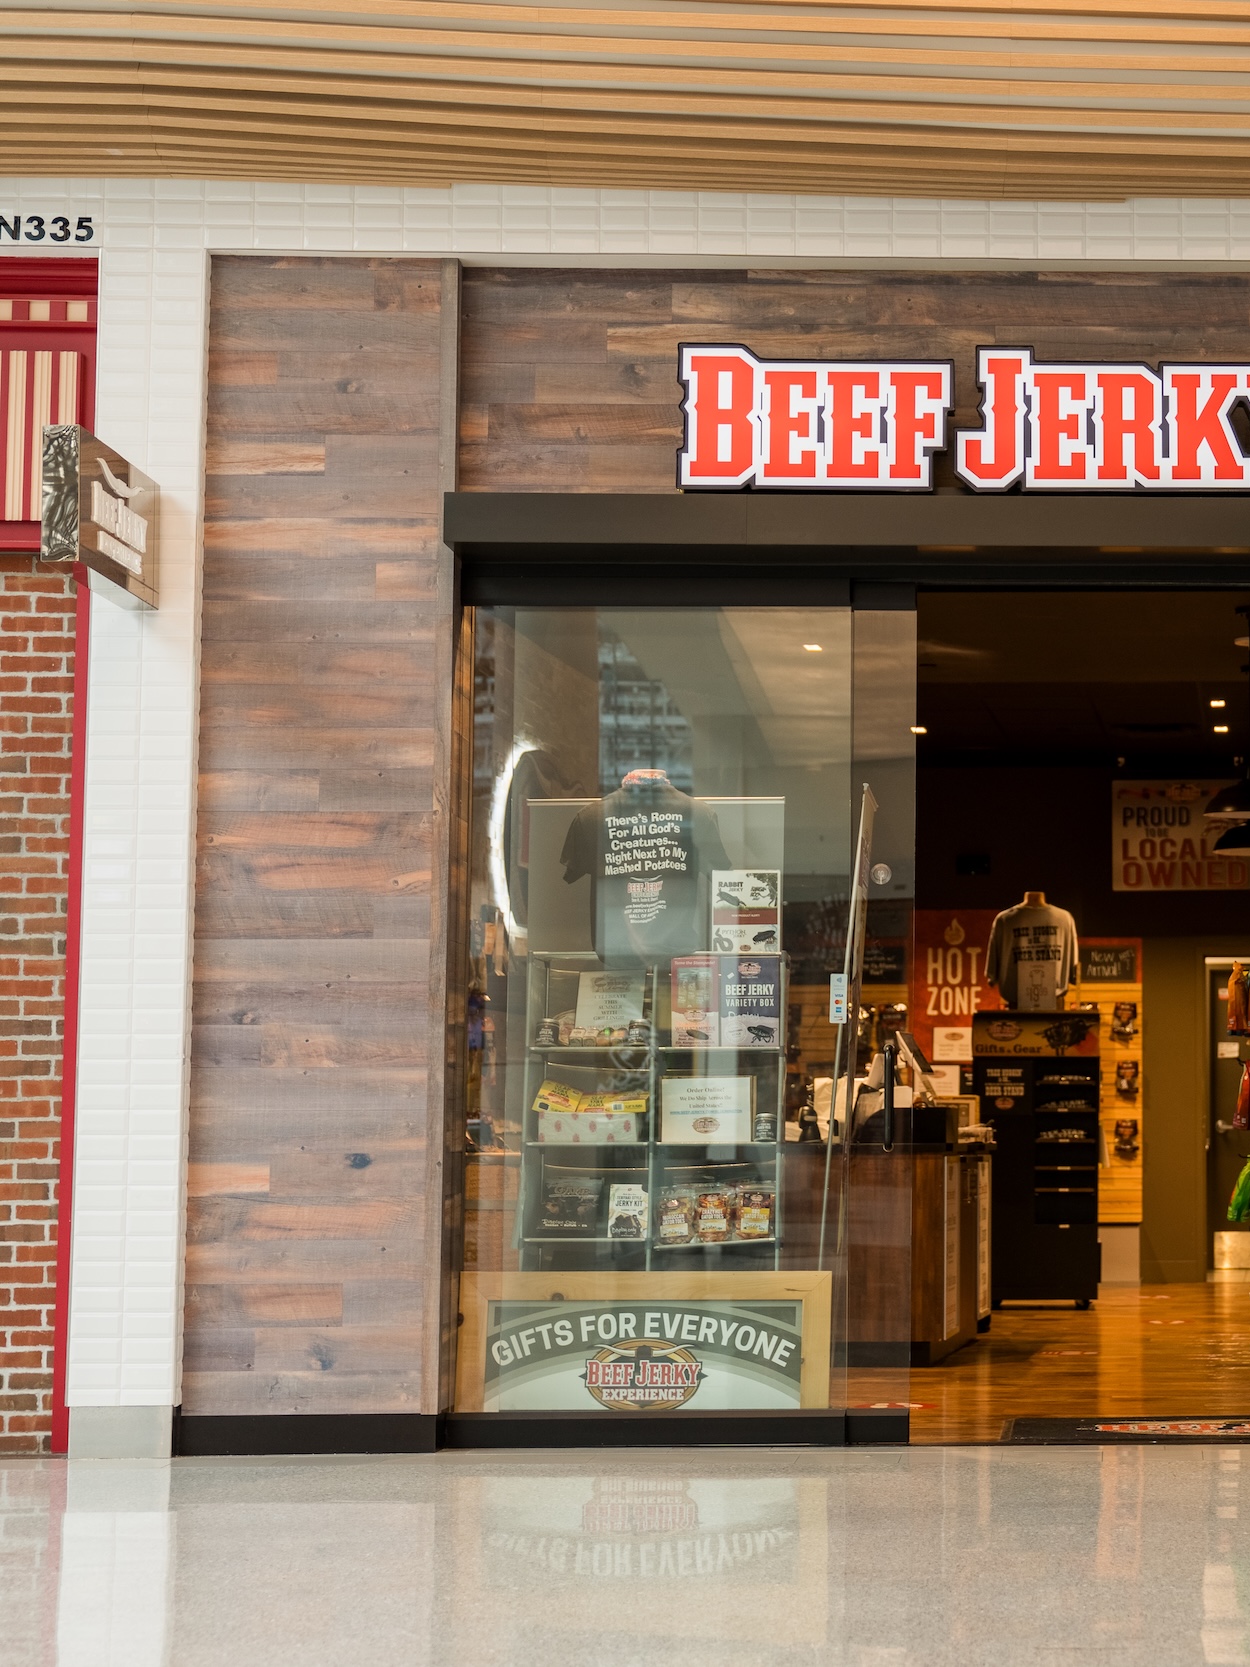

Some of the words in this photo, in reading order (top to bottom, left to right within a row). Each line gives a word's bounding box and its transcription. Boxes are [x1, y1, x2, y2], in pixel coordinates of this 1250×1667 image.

[0, 215, 95, 242] N335
[682, 347, 951, 489] BEEF
[605, 813, 648, 827] There's
[651, 812, 683, 822] Room
[1122, 806, 1191, 828] PROUD
[608, 828, 629, 839] For
[631, 825, 646, 836] All
[648, 822, 680, 835] God's
[611, 837, 678, 851] Creatures...
[1121, 838, 1242, 861] LOCAL
[605, 851, 632, 865] Right
[633, 849, 657, 860] Next
[659, 847, 671, 857] To
[672, 847, 687, 861] My
[605, 861, 642, 876] Mashed
[644, 859, 687, 871] Potatoes
[1122, 861, 1248, 888] OWNED
[927, 947, 982, 985] HOT
[725, 984, 747, 996] BEEF
[748, 984, 775, 996] JERKY
[725, 998, 757, 1007] VARIETY
[759, 998, 775, 1007] BOX
[926, 986, 982, 1016] ZONE
[975, 1043, 1002, 1054] Gifts
[1013, 1043, 1043, 1054] Gear
[491, 1319, 575, 1367] GIFTS
[579, 1312, 638, 1343] FOR
[644, 1312, 797, 1368] EVERYONE
[587, 1360, 633, 1387] BEEF
[636, 1360, 702, 1388] JERKY
[601, 1387, 685, 1401] EXPERIENCE
